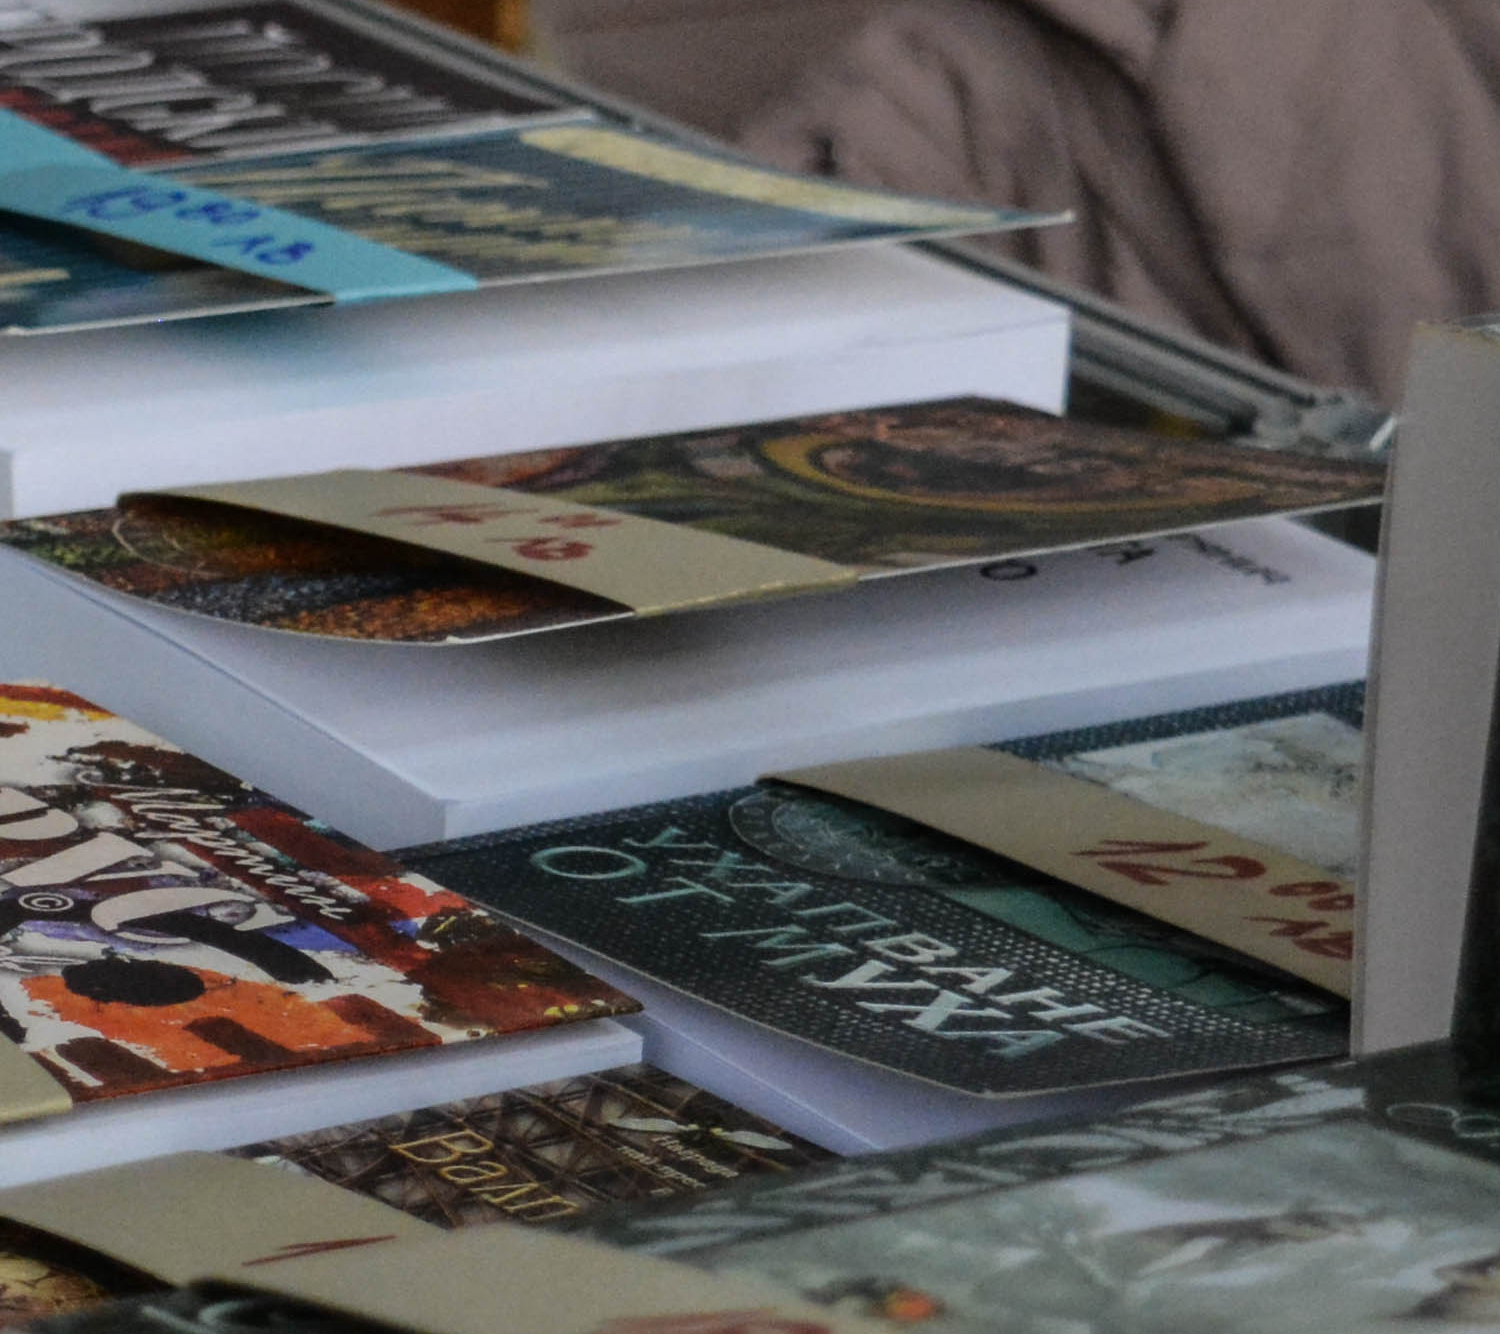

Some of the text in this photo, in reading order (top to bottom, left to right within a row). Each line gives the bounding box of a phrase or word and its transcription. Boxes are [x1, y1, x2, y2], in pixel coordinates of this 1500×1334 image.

[528, 844, 1070, 1060] ОТ МУХА
[622, 825, 1174, 1047] УХАПВАНЕ
